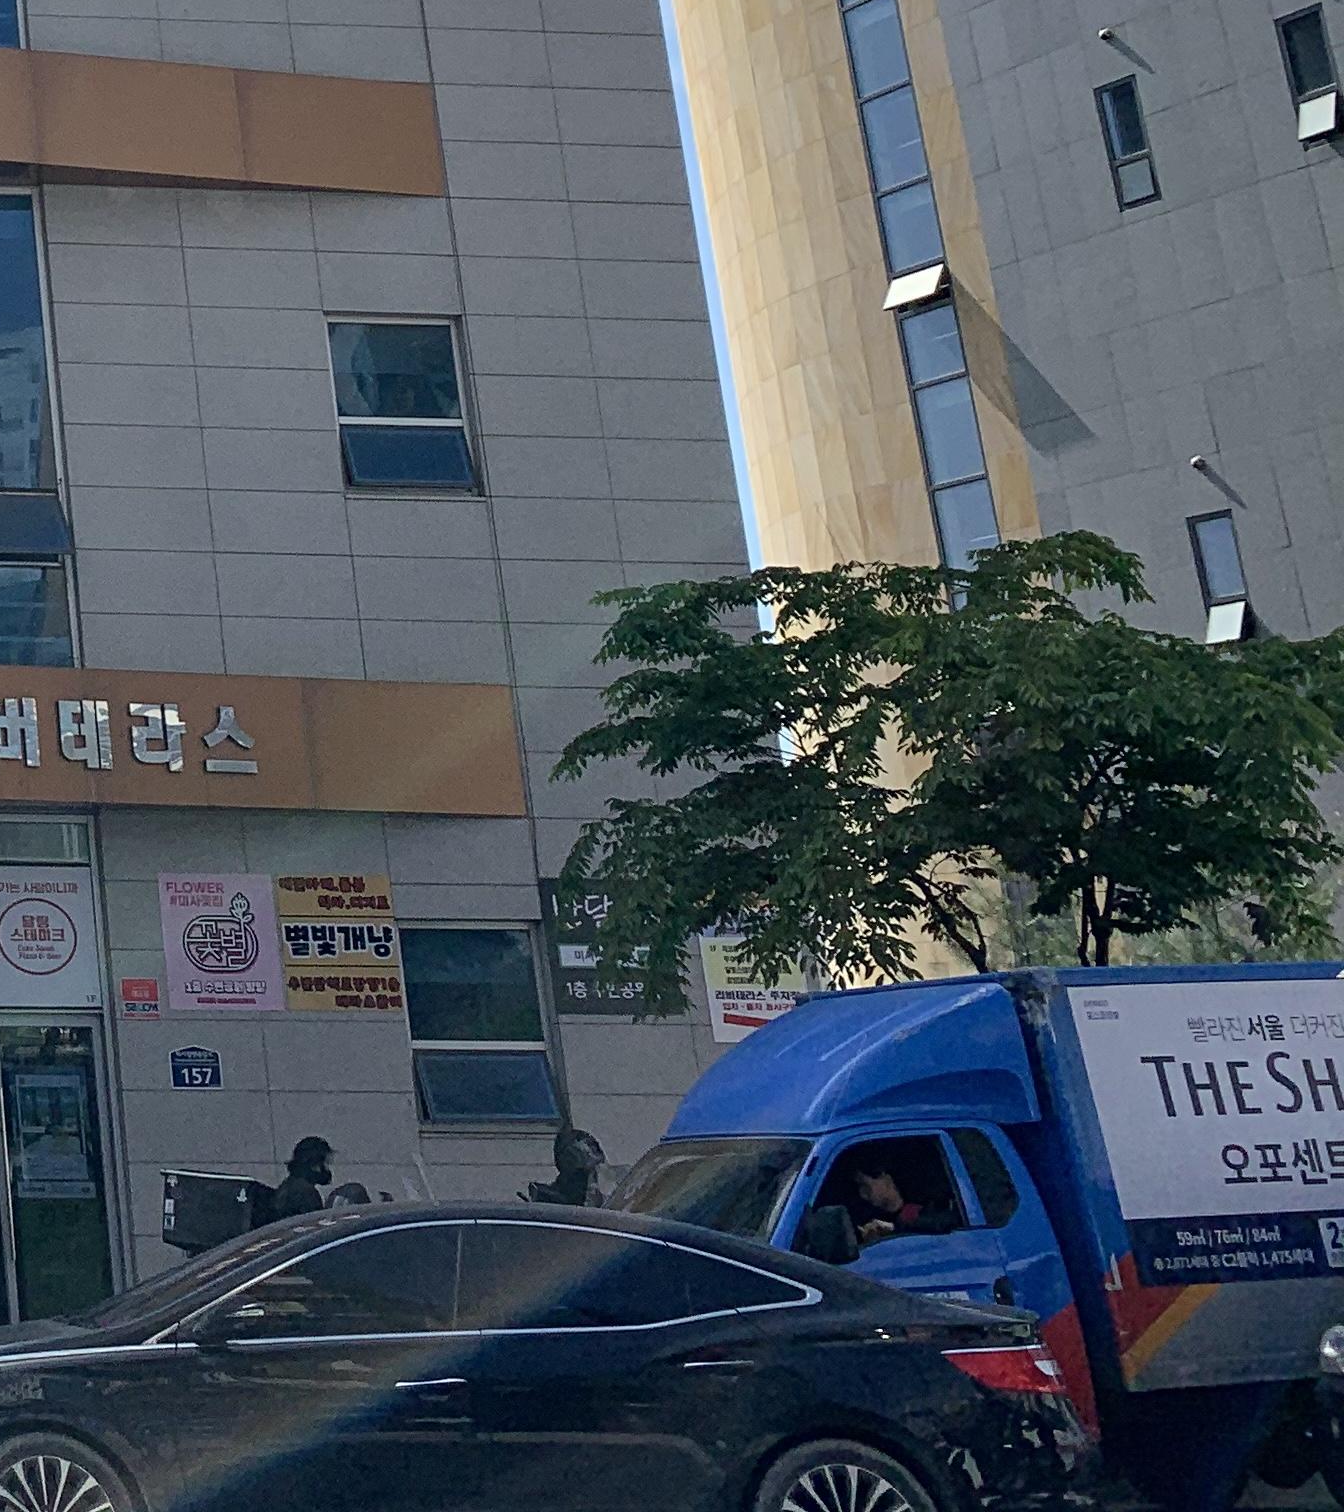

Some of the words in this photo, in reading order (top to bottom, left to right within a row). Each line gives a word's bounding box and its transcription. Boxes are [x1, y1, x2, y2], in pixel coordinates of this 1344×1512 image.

[166, 882, 225, 894] FLOWER
[11, 928, 66, 943] 스테이크
[181, 1068, 213, 1085] 157
